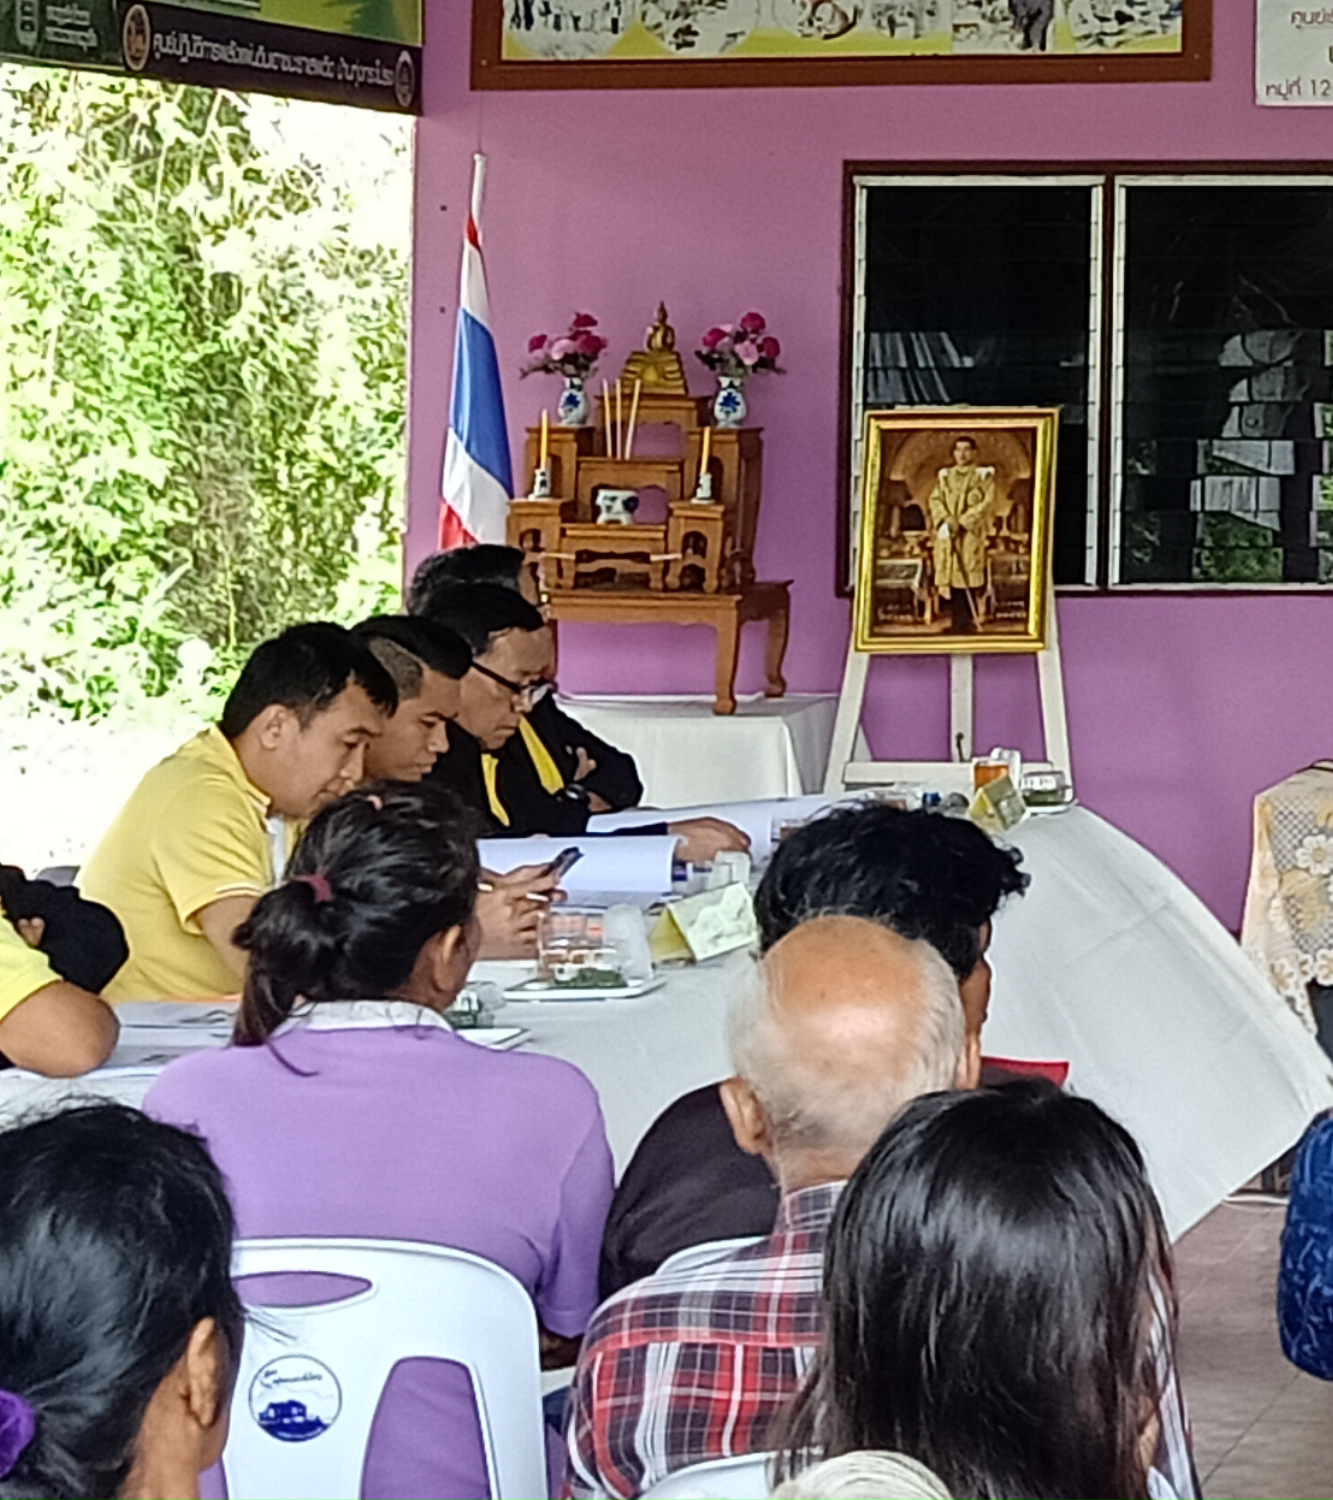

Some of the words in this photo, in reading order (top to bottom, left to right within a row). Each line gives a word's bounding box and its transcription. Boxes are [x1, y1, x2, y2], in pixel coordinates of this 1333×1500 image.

[1265, 77, 1302, 100] หมู่ที่
[1310, 80, 1331, 96] 12
